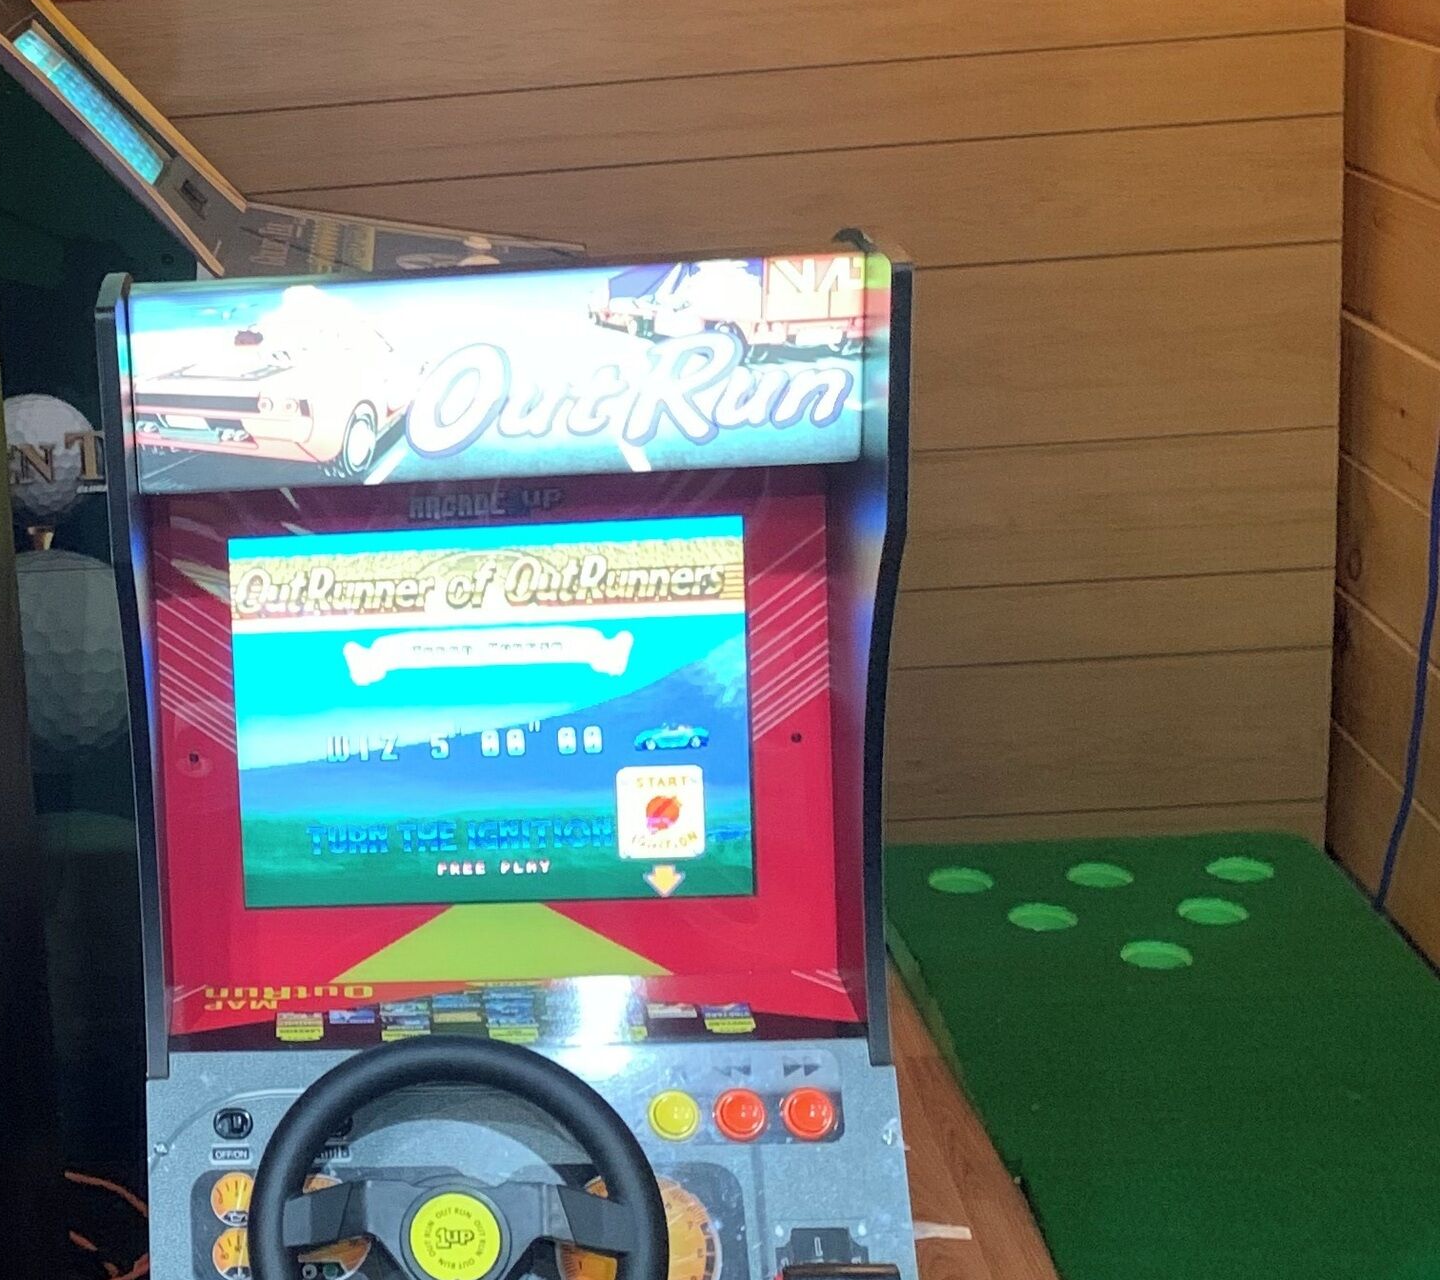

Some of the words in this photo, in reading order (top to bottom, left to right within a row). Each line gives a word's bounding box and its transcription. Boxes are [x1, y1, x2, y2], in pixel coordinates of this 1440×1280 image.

[405, 326, 854, 459] OutRun
[234, 566, 438, 617] OutRunner
[445, 555, 497, 609] of
[505, 554, 726, 606] OutRunners
[636, 776, 687, 788] START
[395, 821, 458, 853] THE
[436, 861, 486, 876] FREE
[500, 859, 551, 875] PLAY
[435, 1206, 452, 1219] OUT
[454, 1207, 472, 1219] RUN
